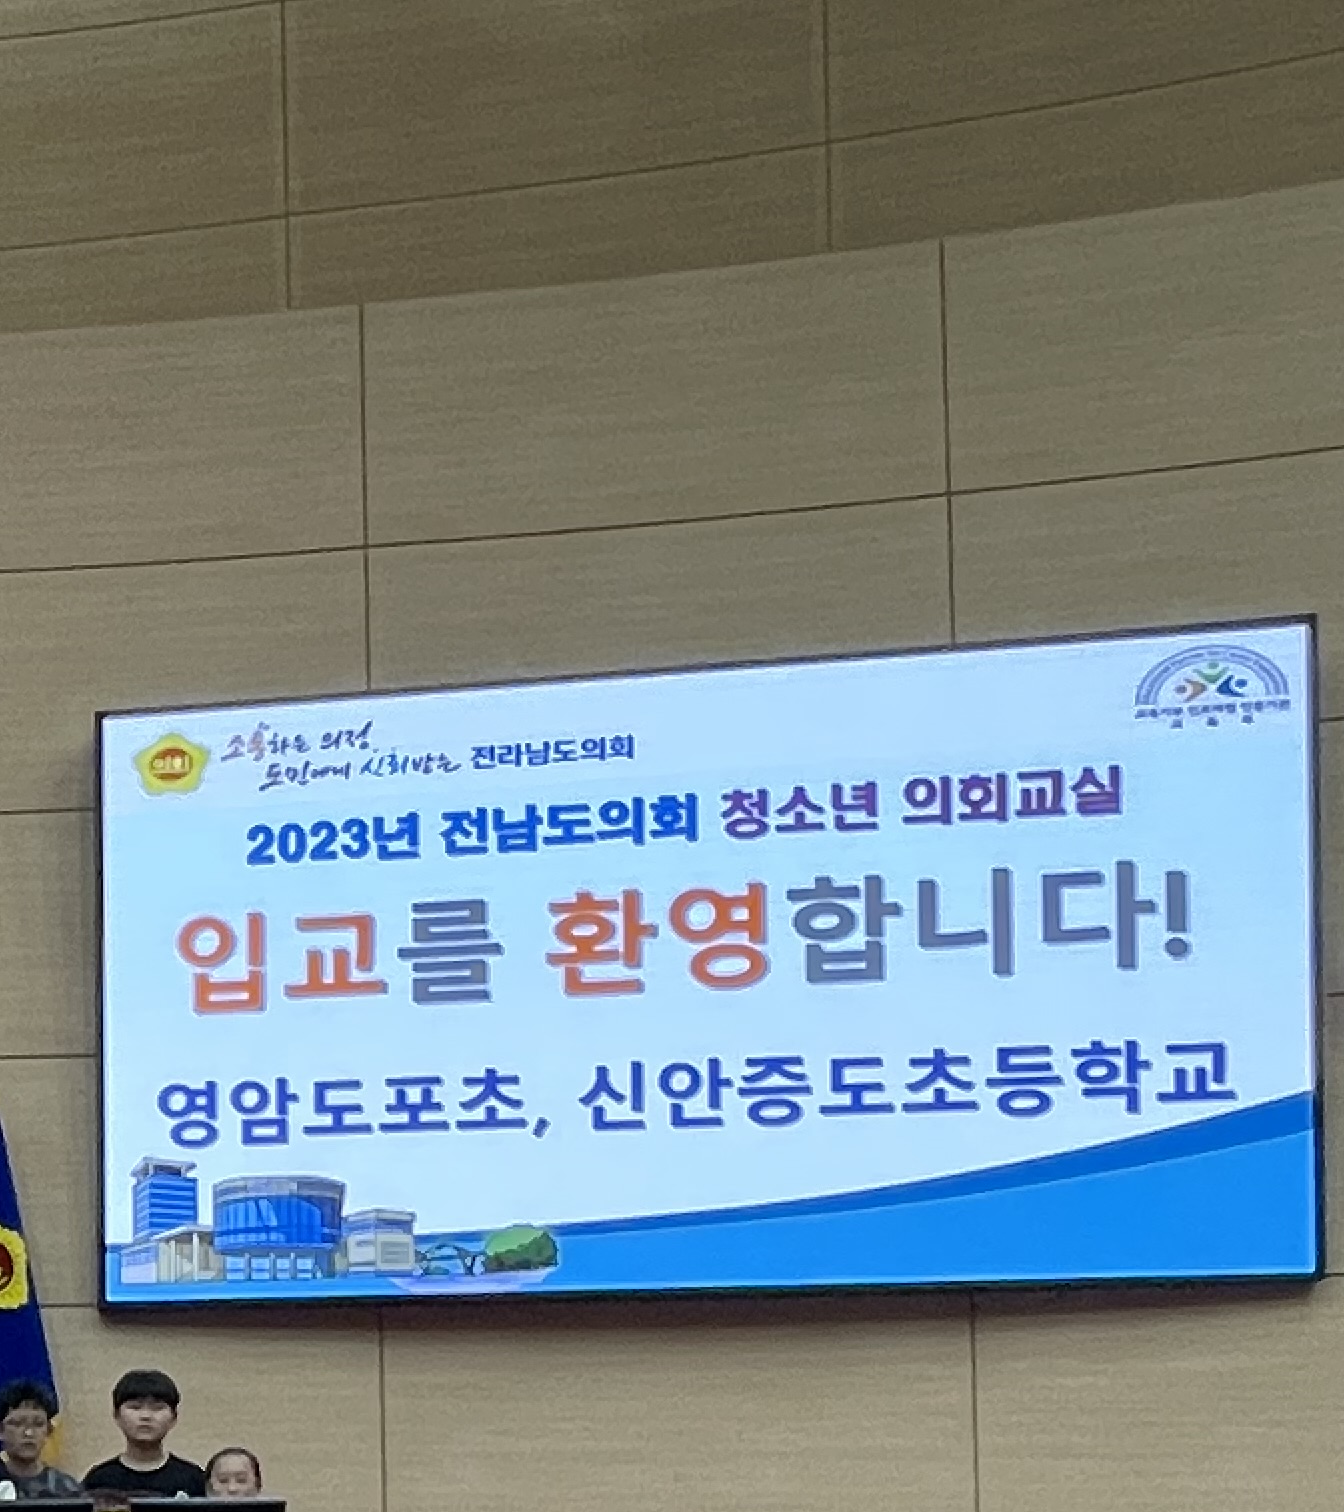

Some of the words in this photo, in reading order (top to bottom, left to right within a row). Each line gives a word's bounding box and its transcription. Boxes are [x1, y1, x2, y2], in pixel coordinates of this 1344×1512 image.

[471, 733, 633, 769] 전라남도의회
[247, 811, 421, 865] 2023년
[439, 793, 699, 857] 전남도의회
[721, 781, 879, 839] 청소년
[901, 765, 1123, 825] 의회교실
[179, 899, 505, 1014] 입교를
[545, 859, 1191, 995] 환영합니다!
[157, 1068, 551, 1149] 영암도포초,
[579, 1040, 1238, 1131] 신안증도초등학교
